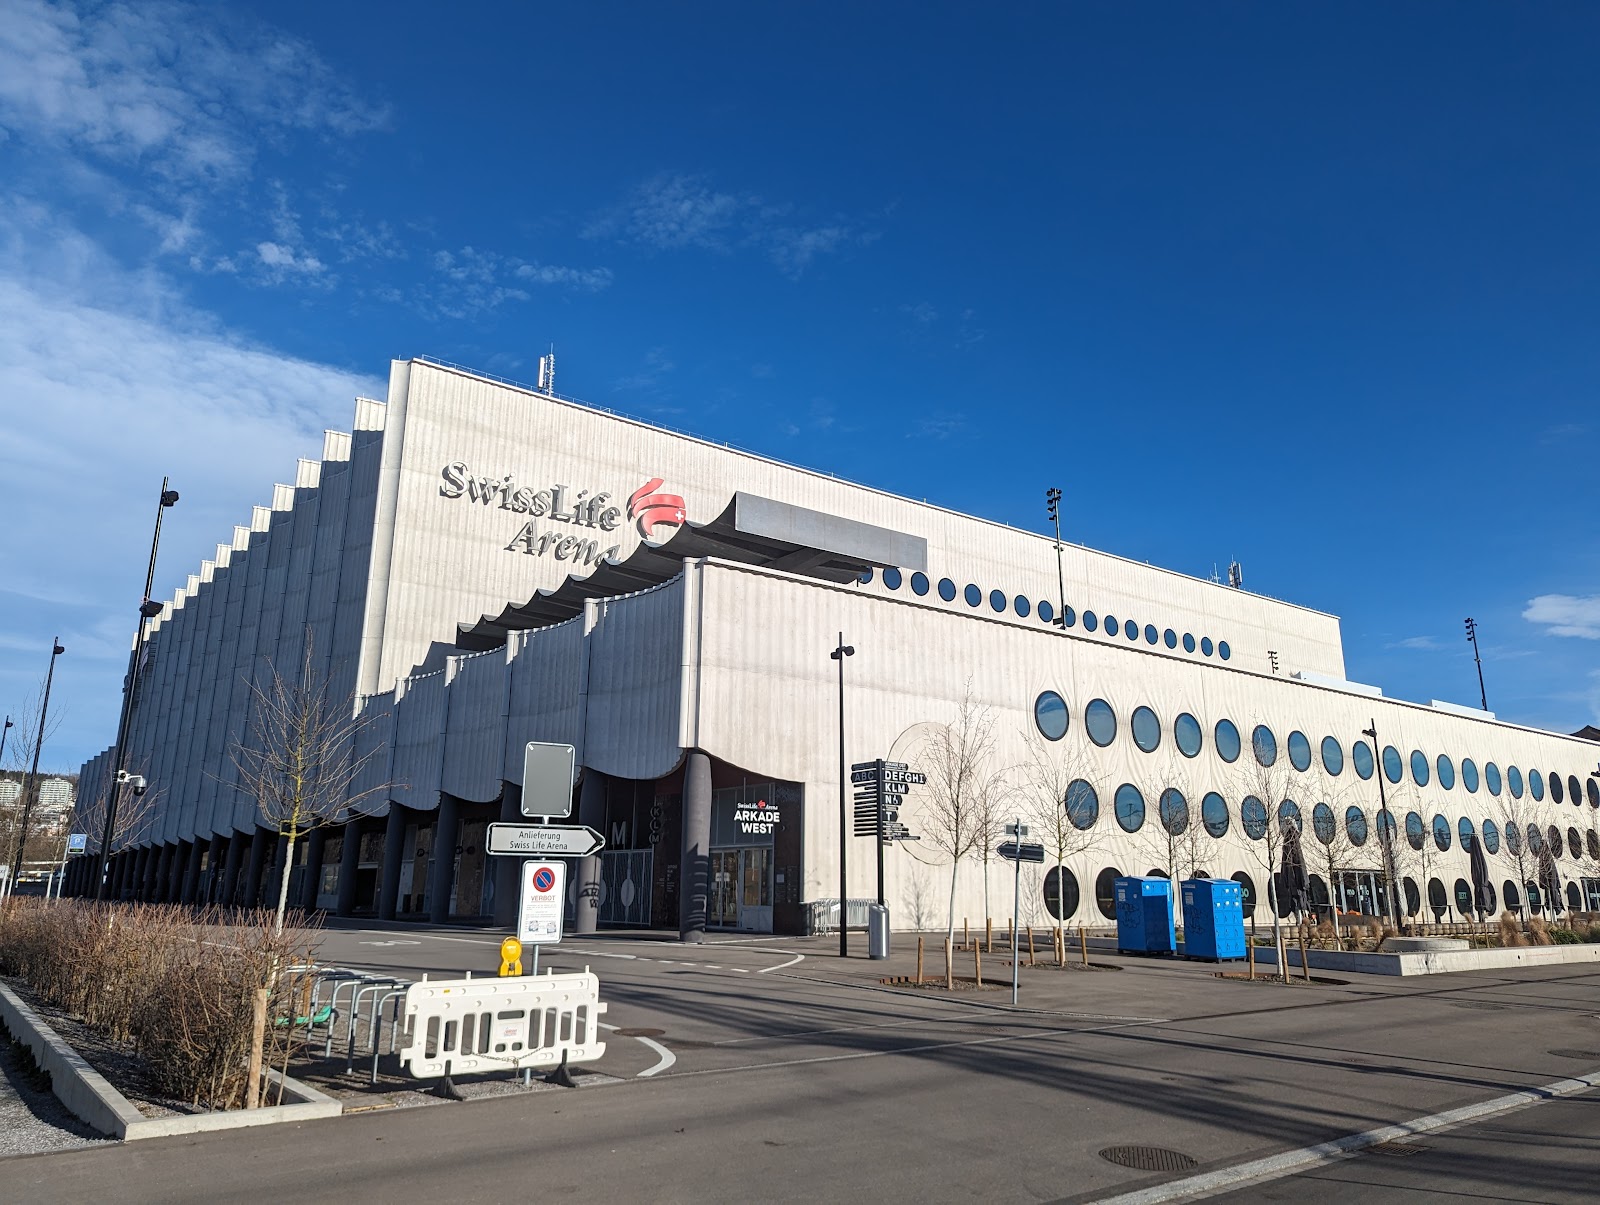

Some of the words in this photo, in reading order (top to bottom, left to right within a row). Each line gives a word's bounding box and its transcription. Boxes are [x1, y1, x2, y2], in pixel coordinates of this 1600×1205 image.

[503, 517, 622, 567] Arena
[885, 771, 924, 783] DEFGHI
[885, 783, 905, 793] KLM
[885, 795, 892, 804] N
[733, 810, 780, 823] ARKADE
[886, 812, 892, 821] T
[612, 821, 626, 846] M
[741, 822, 774, 834] WEST
[519, 831, 560, 841] Anlieferung
[509, 840, 530, 849] Swiss
[532, 841, 546, 850] Life
[547, 841, 568, 850] Arena
